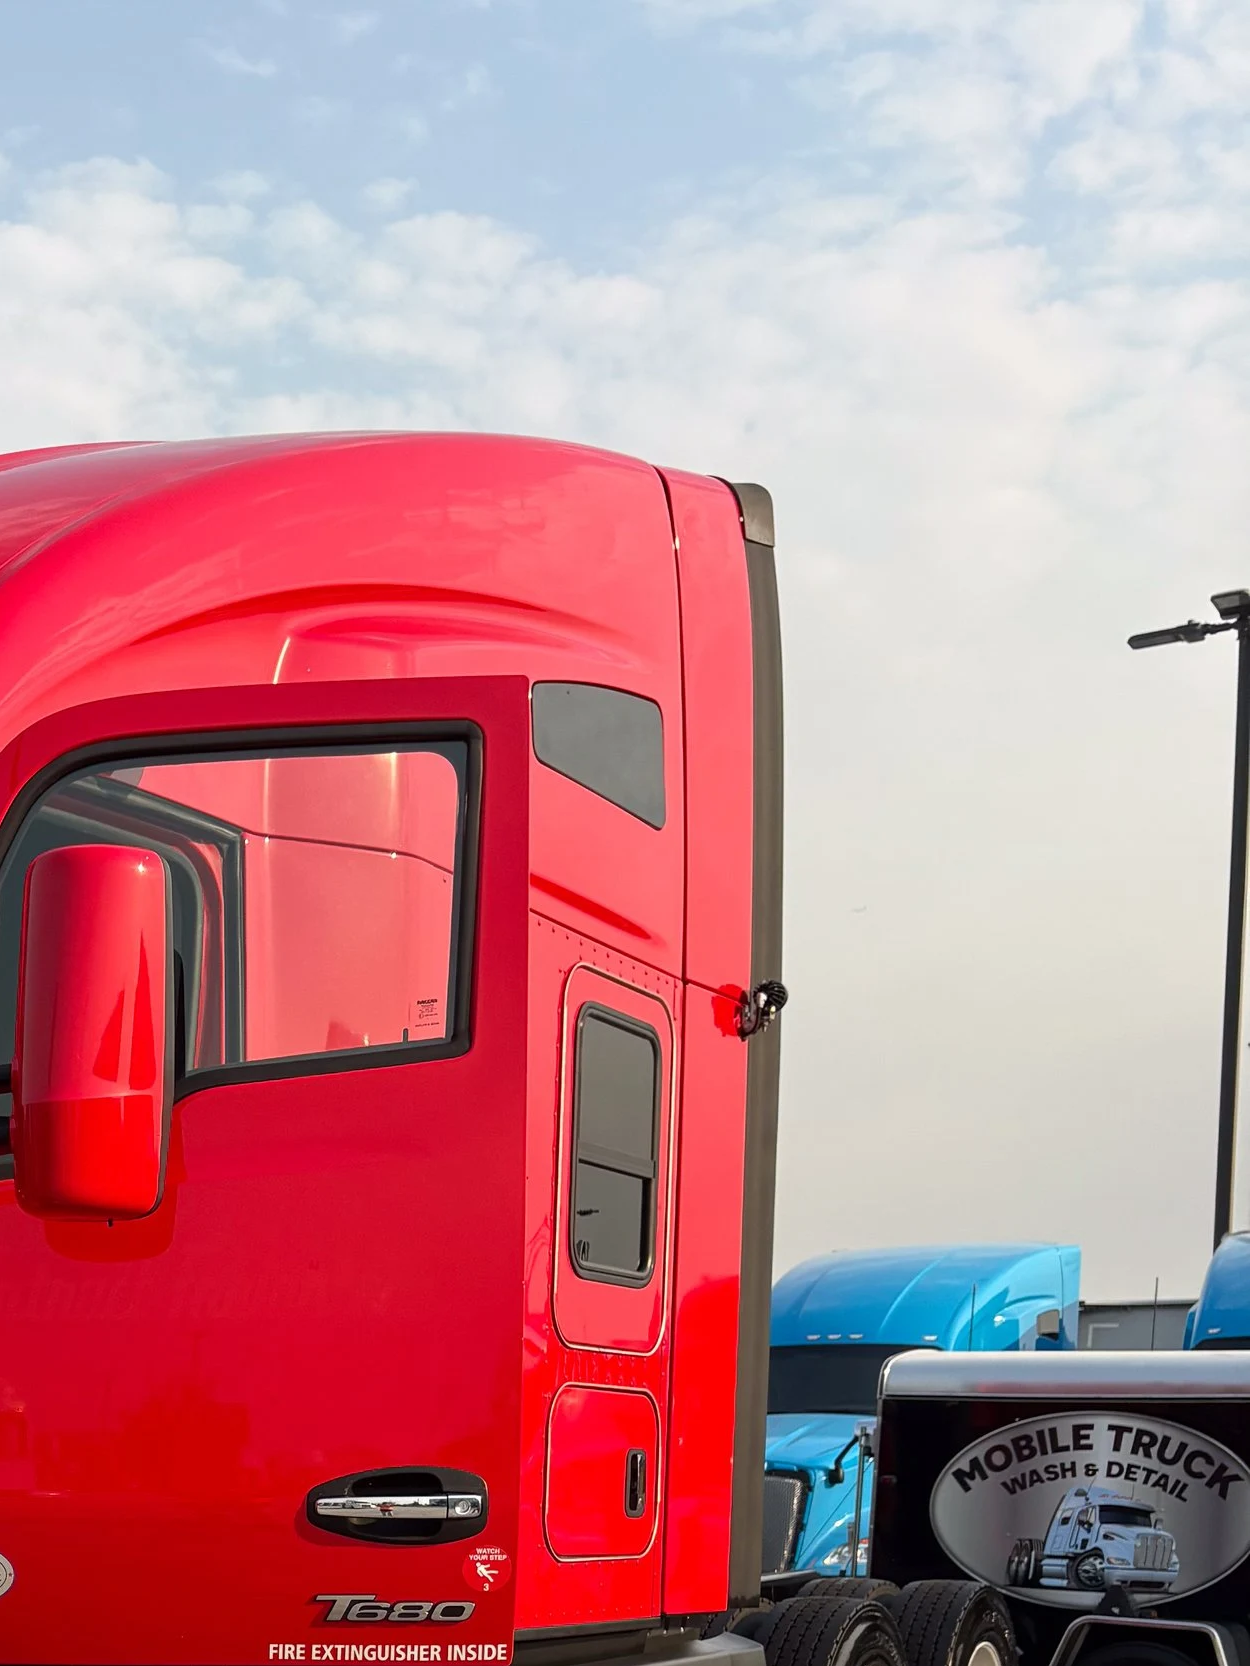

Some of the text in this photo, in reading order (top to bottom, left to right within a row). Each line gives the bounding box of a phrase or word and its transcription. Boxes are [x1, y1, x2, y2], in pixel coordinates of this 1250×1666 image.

[952, 1423, 1244, 1500] MOBILE TRUCK
[1001, 1461, 1193, 1502] WASH & DETAIL
[483, 1583, 489, 1591] 3
[315, 1594, 476, 1622] T680
[269, 1643, 507, 1661] FIRE EXTINGUISHER INSIDE
